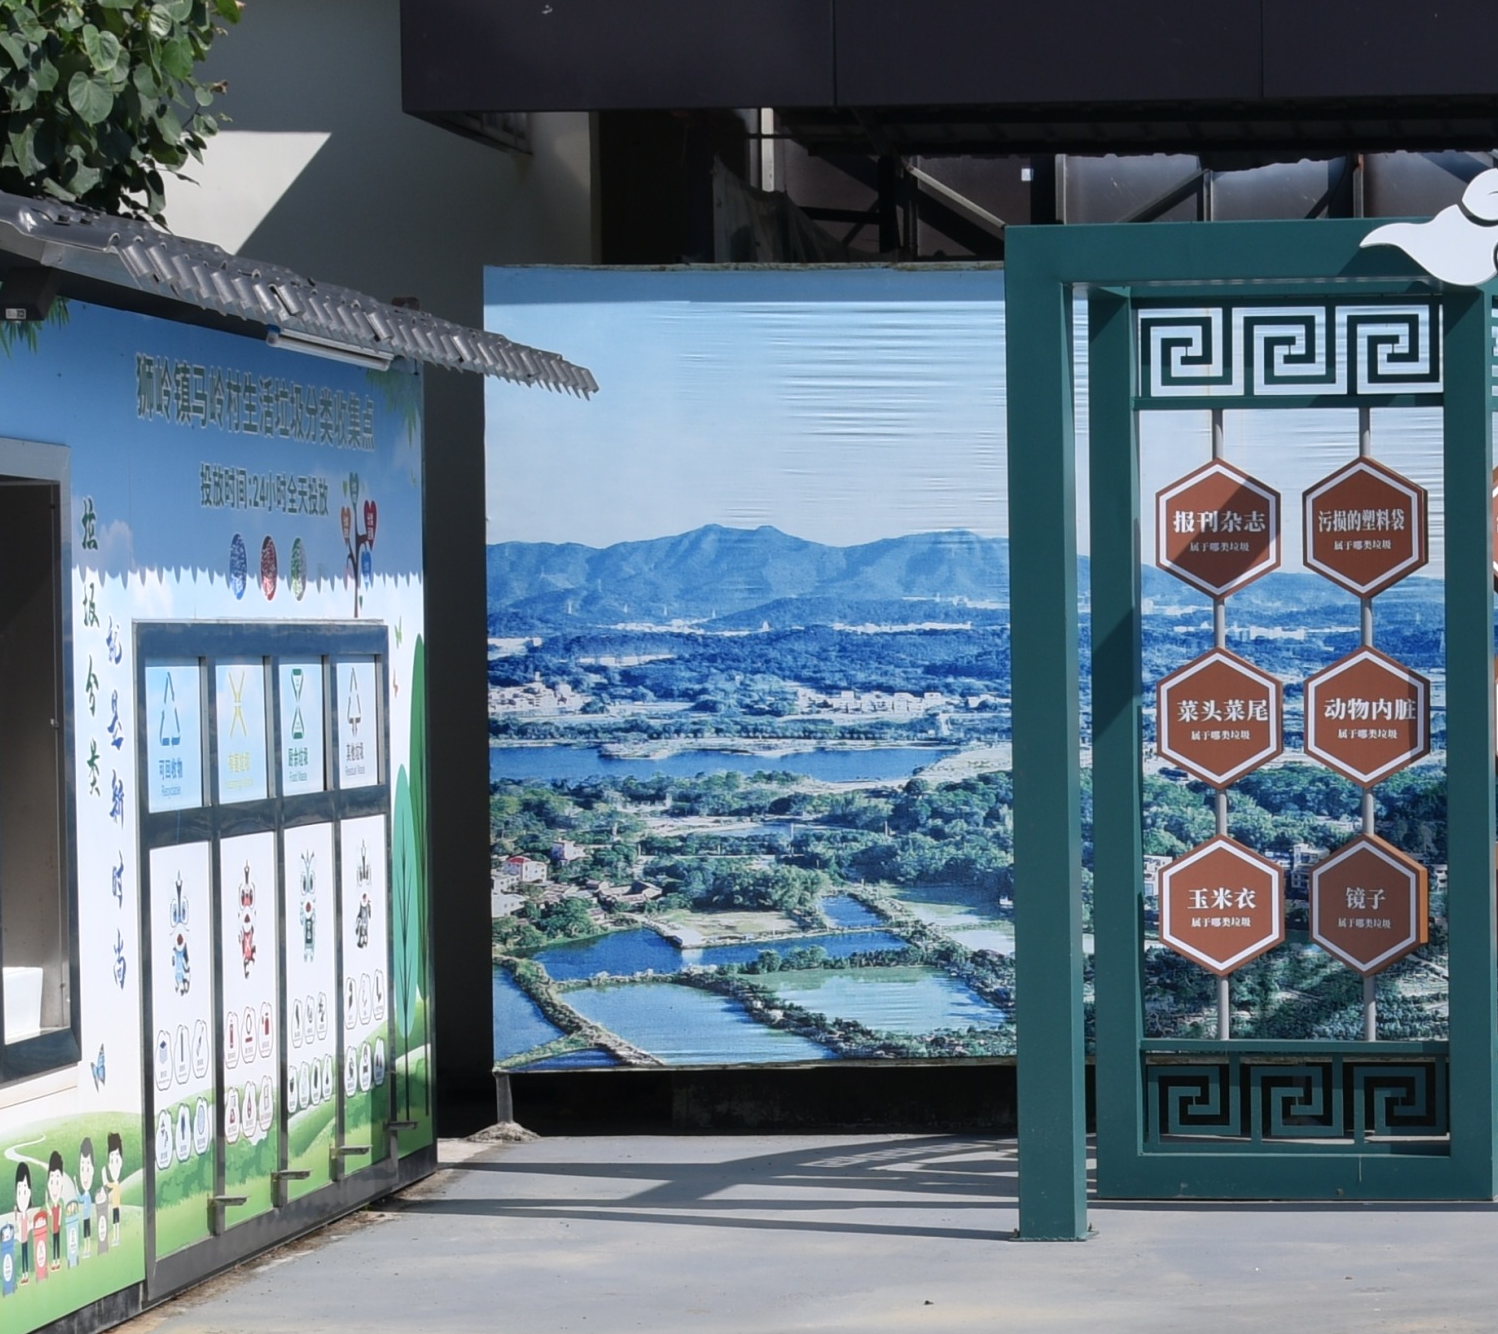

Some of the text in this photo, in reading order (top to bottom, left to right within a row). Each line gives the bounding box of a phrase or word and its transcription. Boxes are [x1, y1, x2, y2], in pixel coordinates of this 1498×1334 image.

[135, 352, 375, 452] 狮岭镇马岭村生活垃圾分类收集点
[1173, 510, 1266, 533] 报刊杂志
[1317, 508, 1405, 533] 污损的塑料袋
[80, 497, 101, 797] 垃圾分类
[1177, 699, 1269, 723] 菜头菜尾
[1323, 698, 1416, 722] 动物内脏
[105, 615, 128, 991] 就是新时尚
[1187, 888, 1257, 910] 玉米衣
[1345, 887, 1386, 911] 镜子
